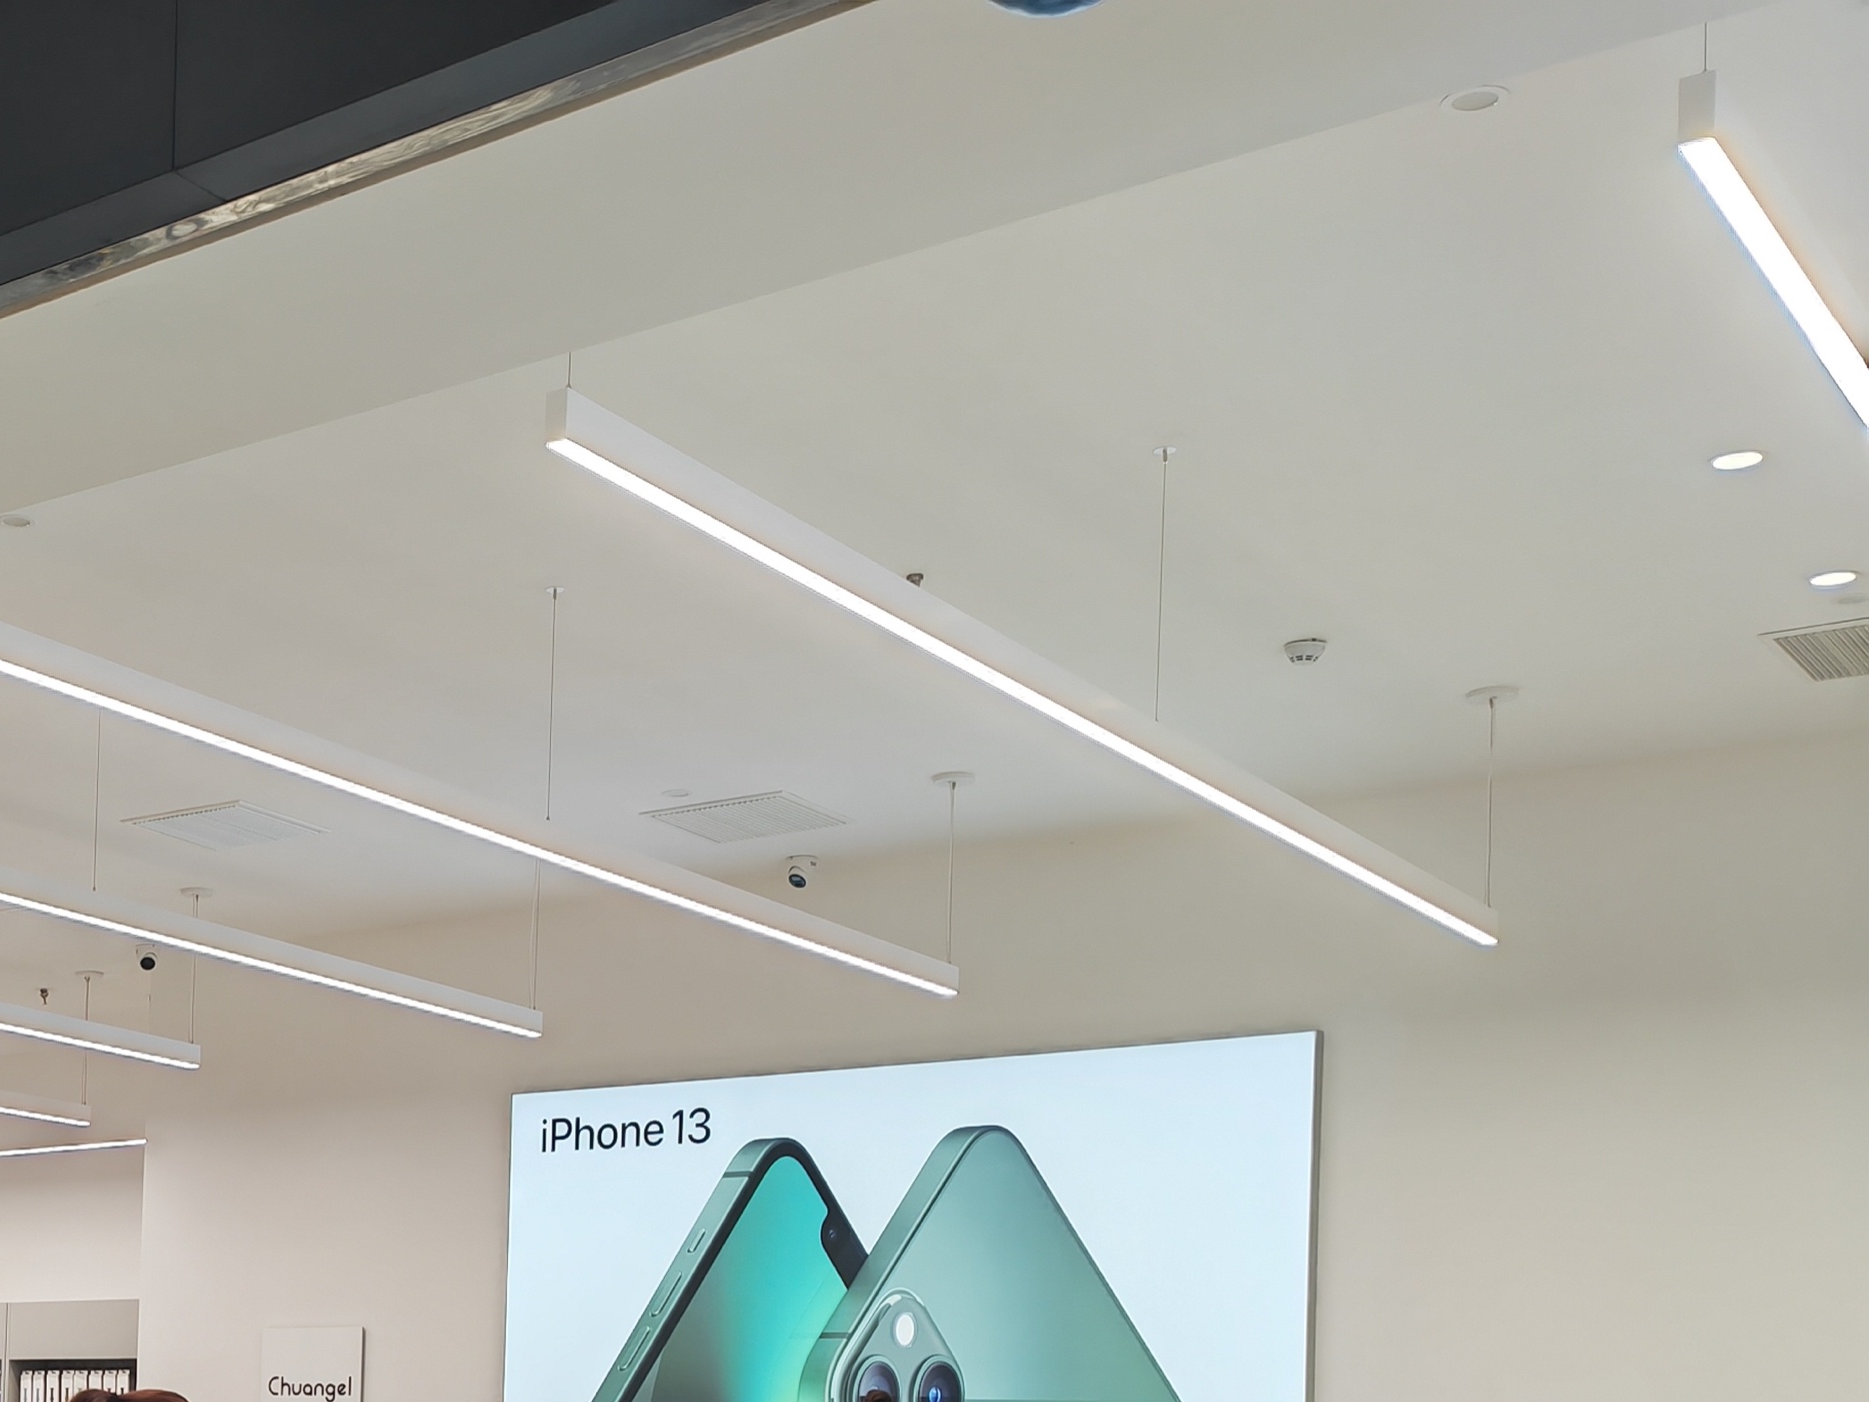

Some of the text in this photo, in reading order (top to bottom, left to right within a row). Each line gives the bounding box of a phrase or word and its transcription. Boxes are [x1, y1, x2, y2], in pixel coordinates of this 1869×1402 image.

[540, 1106, 712, 1154] iPhone 13
[268, 1375, 352, 1402] Chuangel
